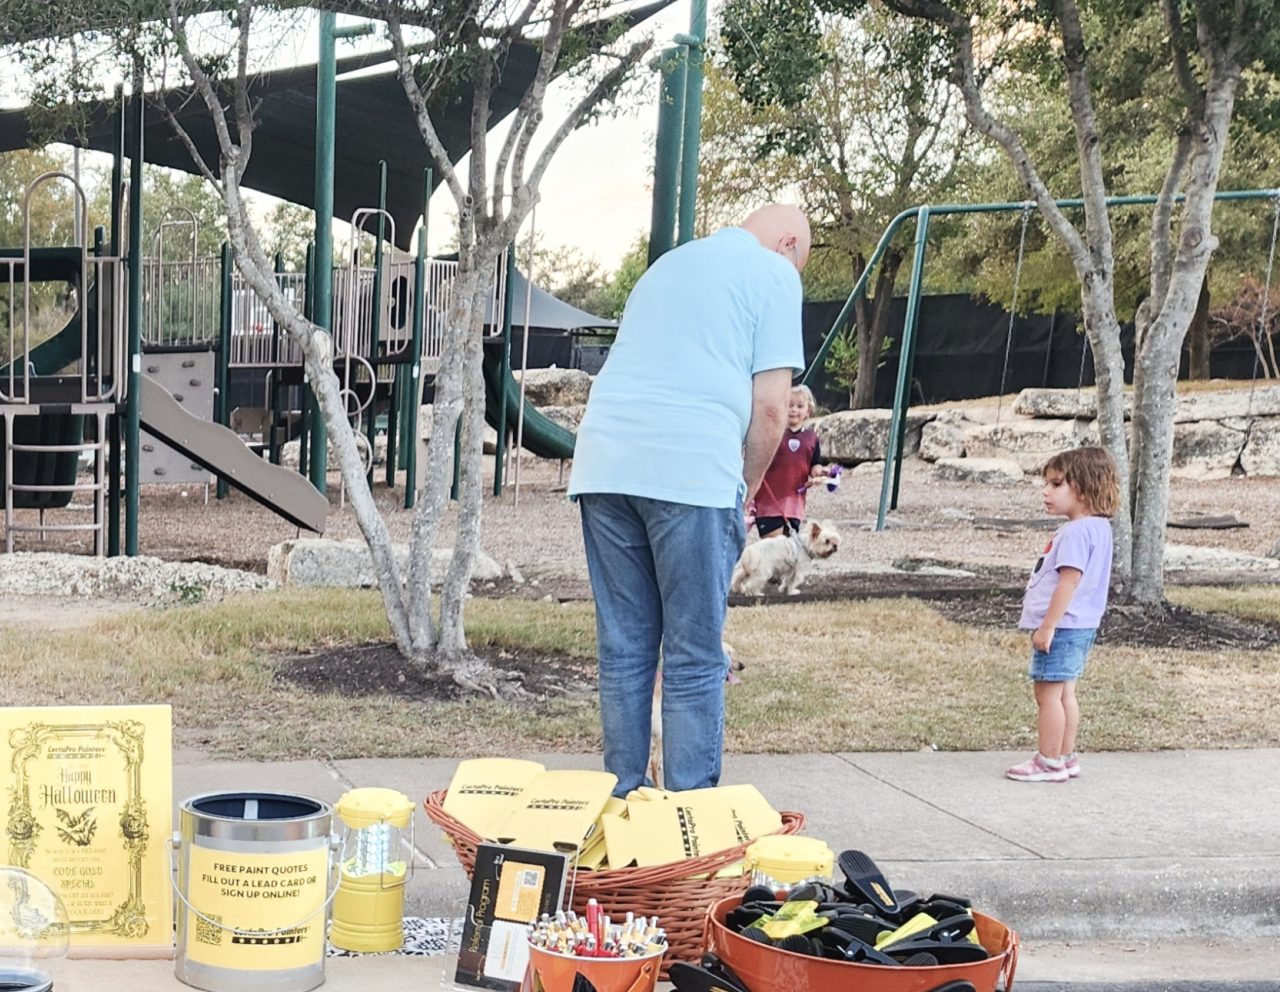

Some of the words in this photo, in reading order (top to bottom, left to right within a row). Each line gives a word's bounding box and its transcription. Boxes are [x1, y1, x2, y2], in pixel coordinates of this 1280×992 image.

[58, 767, 92, 785] Happy
[39, 784, 116, 811] Halloween
[79, 866, 103, 876] GOLD
[214, 863, 237, 873] FREE
[239, 866, 269, 874] PAINT
[272, 864, 308, 875] QUOTES
[202, 874, 218, 884] FILL
[221, 877, 240, 887] OUT
[242, 879, 250, 888] A
[252, 879, 278, 888] LEAD
[280, 877, 305, 887] CARD
[307, 875, 317, 885] OR
[221, 888, 244, 898] SIGN
[246, 890, 260, 899] UP
[262, 889, 301, 899] ONLINE!
